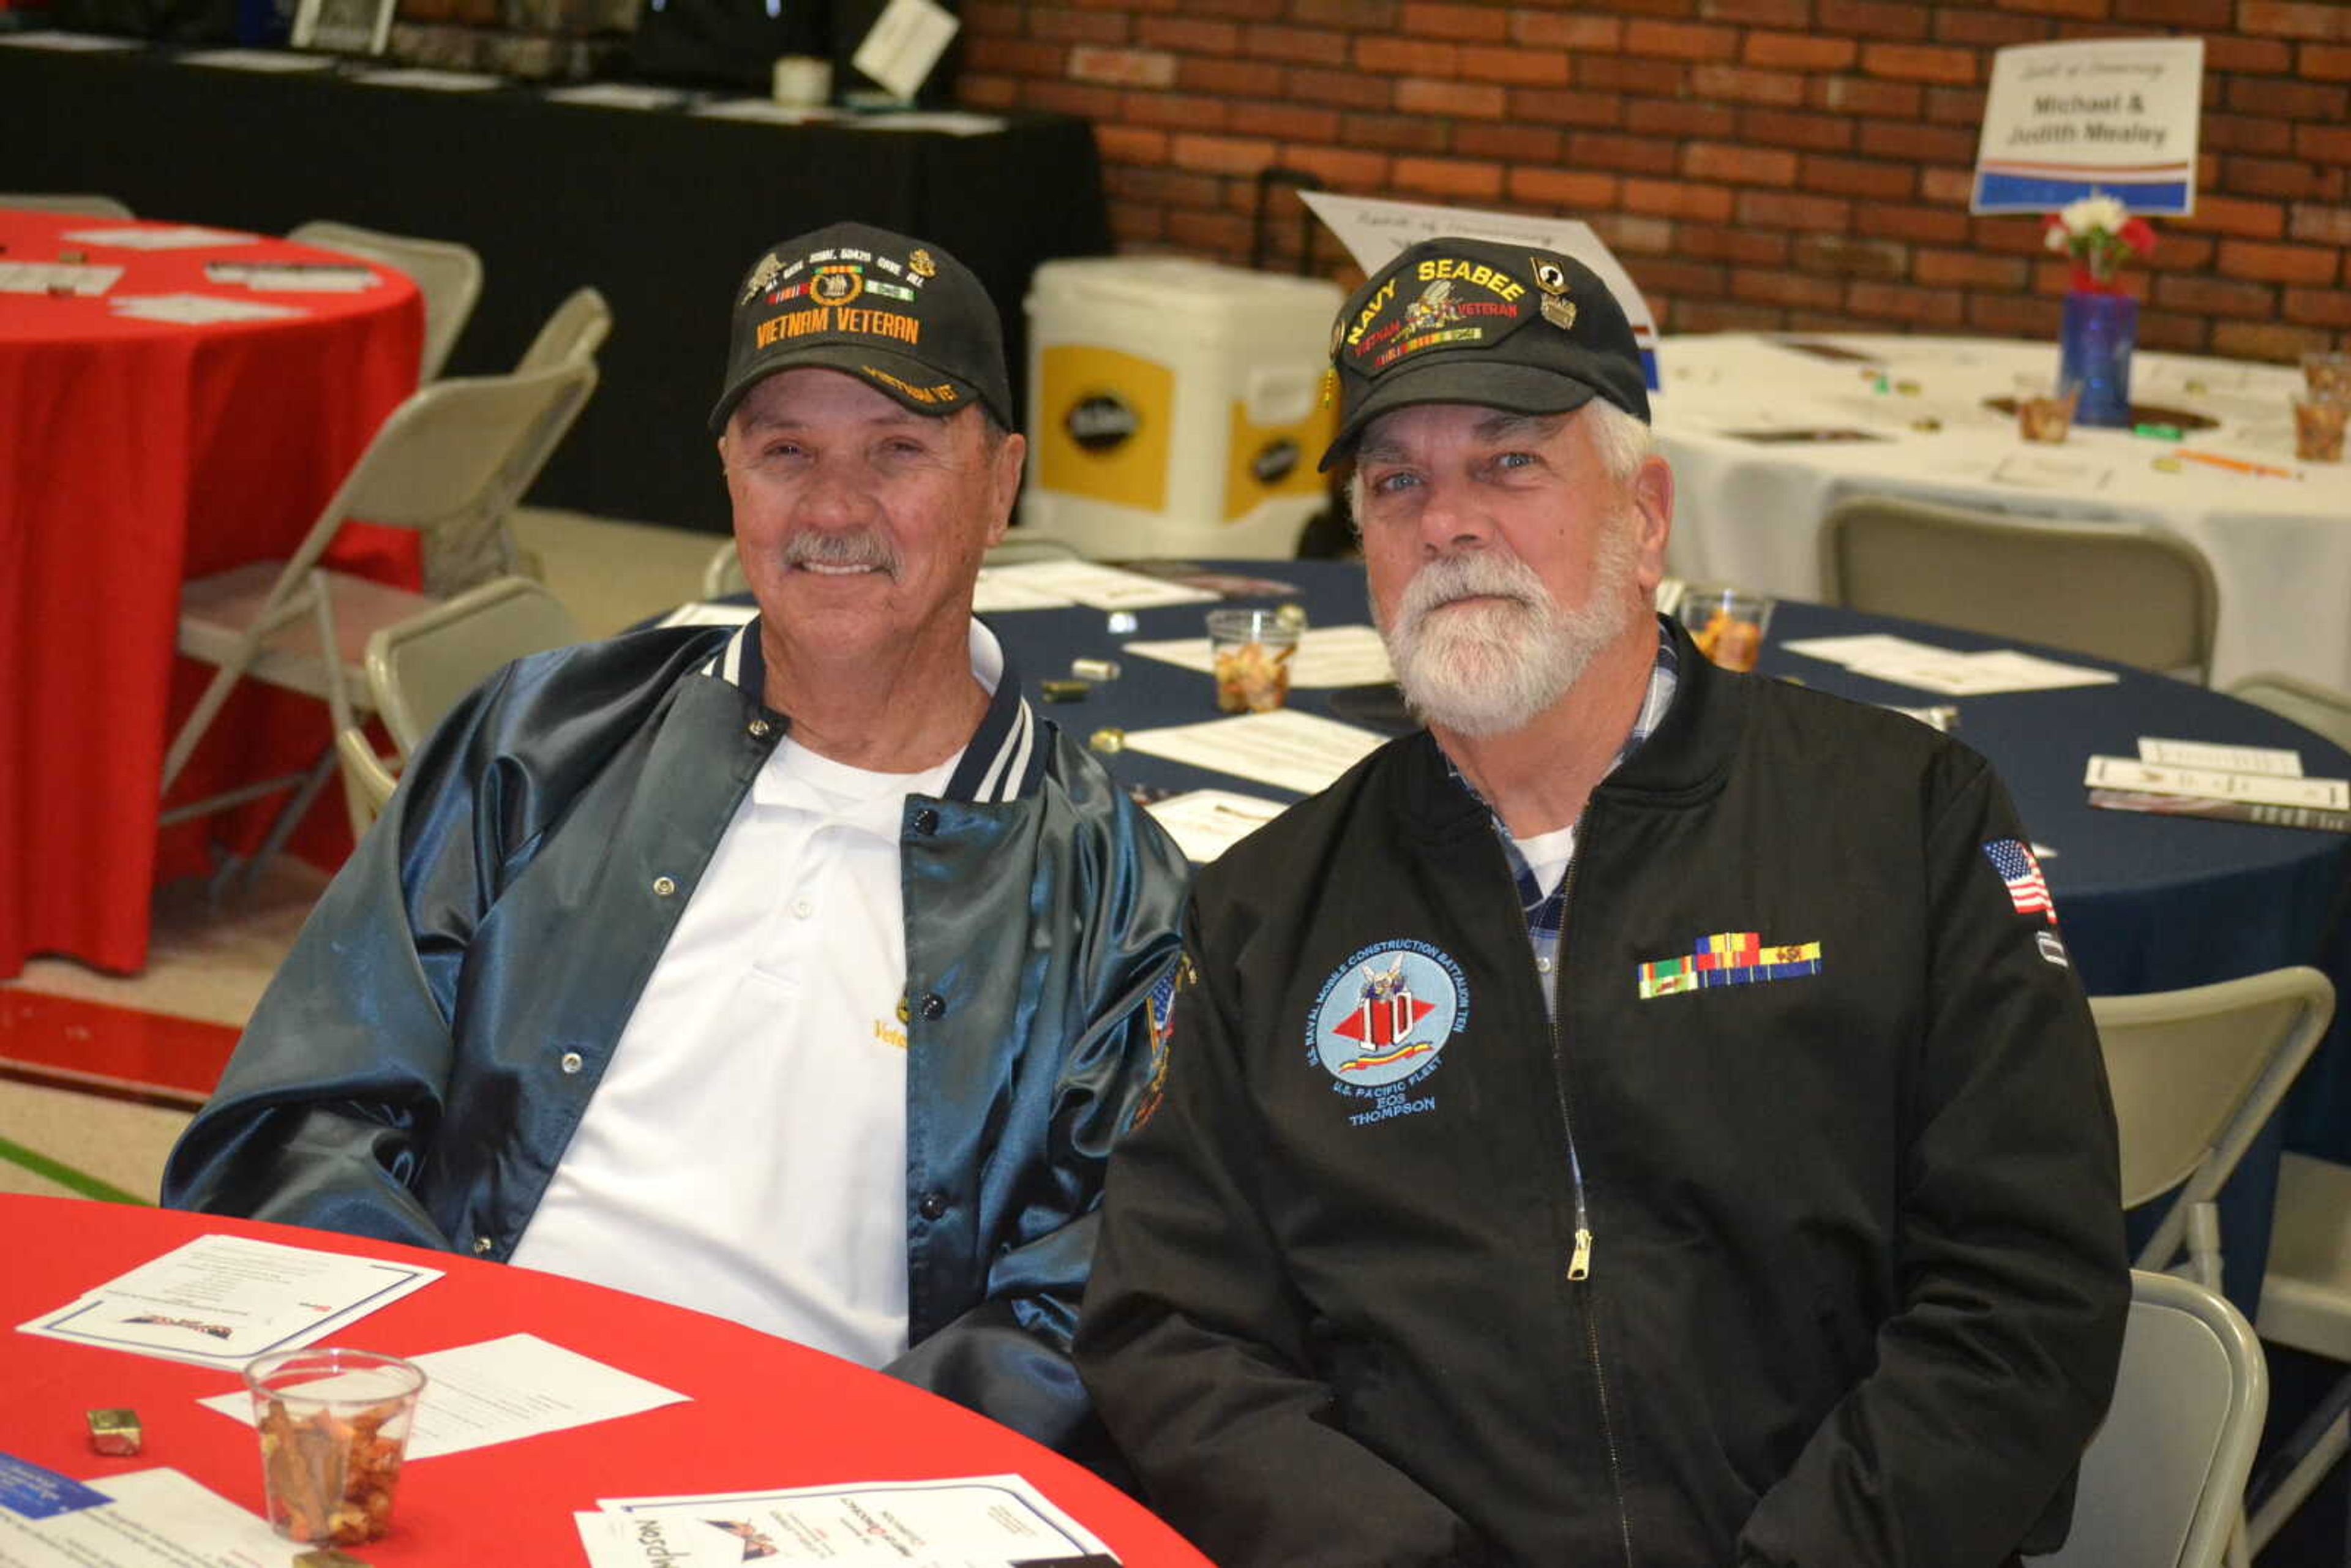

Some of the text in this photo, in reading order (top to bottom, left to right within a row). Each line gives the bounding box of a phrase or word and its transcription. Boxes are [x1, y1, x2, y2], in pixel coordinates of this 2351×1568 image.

[2128, 94, 2146, 114] &
[1347, 258, 1525, 346] NAVY SEABEE
[1458, 302, 1518, 318] VETERAN
[756, 307, 920, 350] VIETNAM VETERAN
[1348, 939, 1439, 966] CONSTRUCTION
[1436, 952, 1470, 1008] BATTALION
[1355, 1081, 1407, 1098] PACIFIC
[1409, 1056, 1443, 1086] FLEET
[1349, 1096, 1436, 1127] THOMPSON
